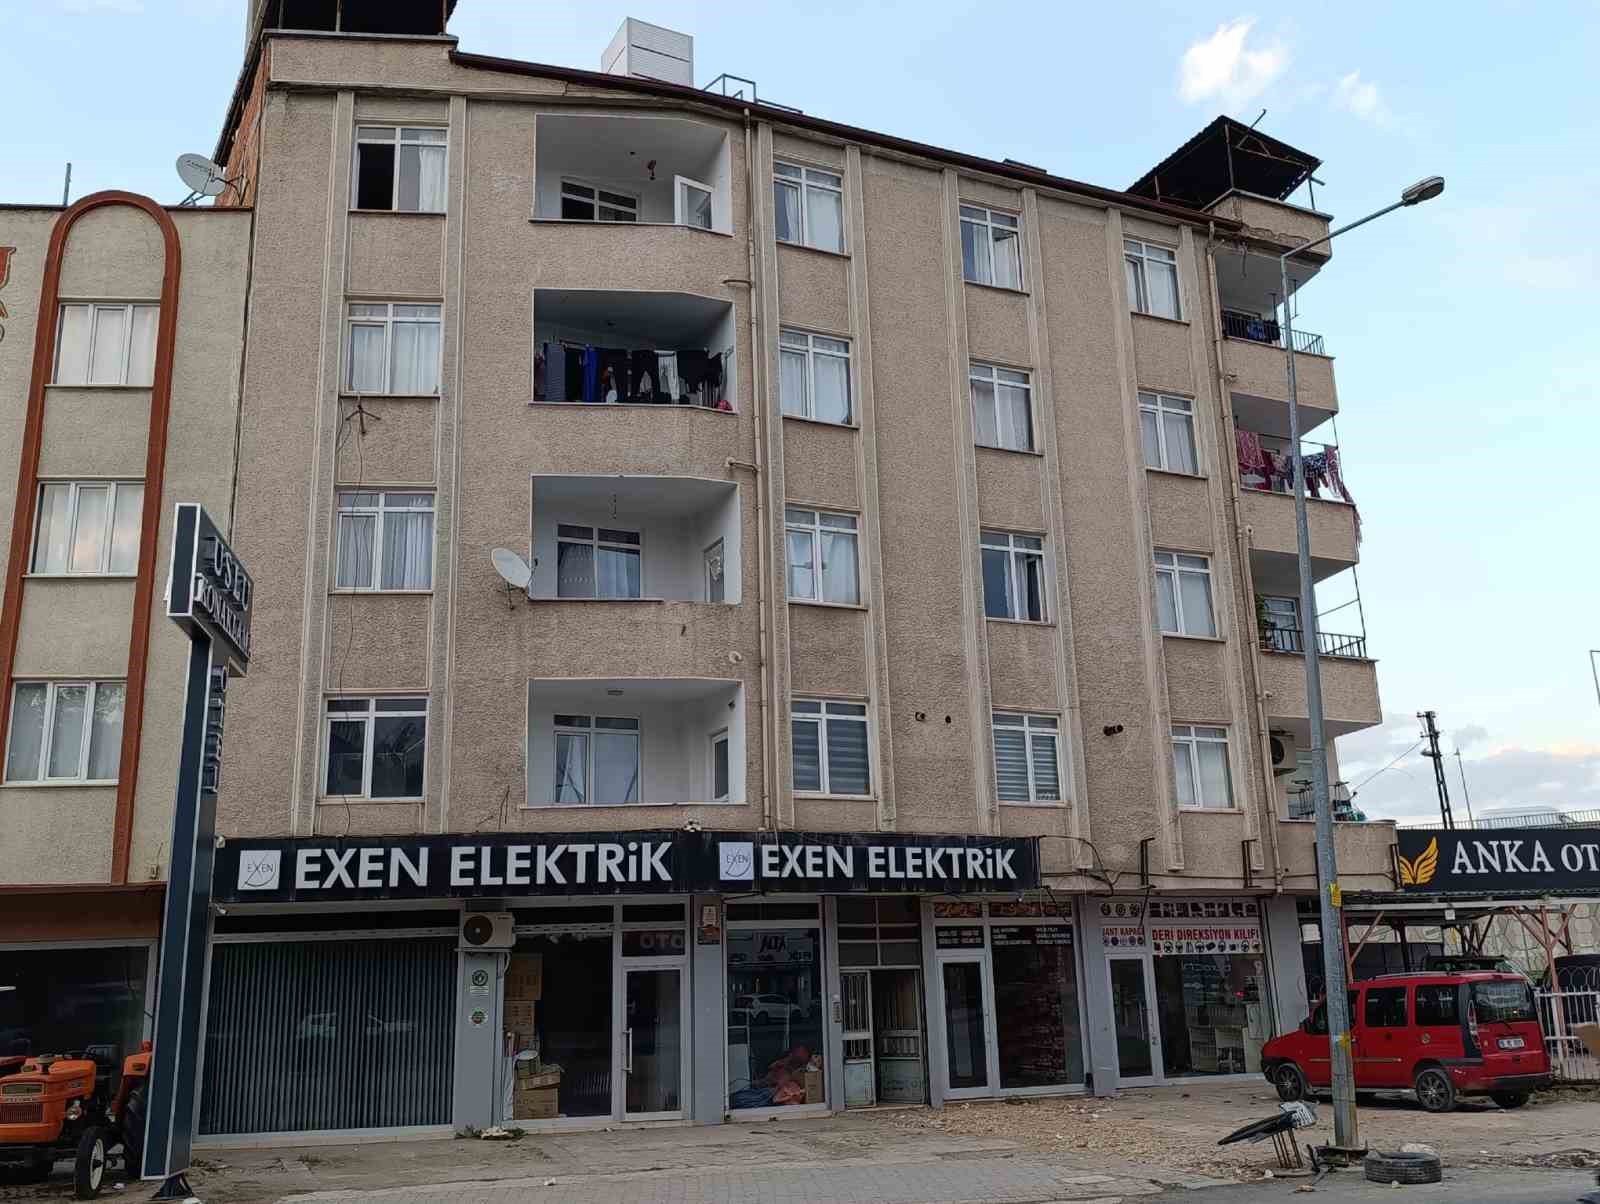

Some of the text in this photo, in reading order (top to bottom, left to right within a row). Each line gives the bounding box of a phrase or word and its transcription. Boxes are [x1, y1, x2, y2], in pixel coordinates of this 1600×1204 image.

[294, 847, 429, 889] EXEN
[761, 844, 854, 879] EXEN
[1451, 840, 1555, 874] ANKA
